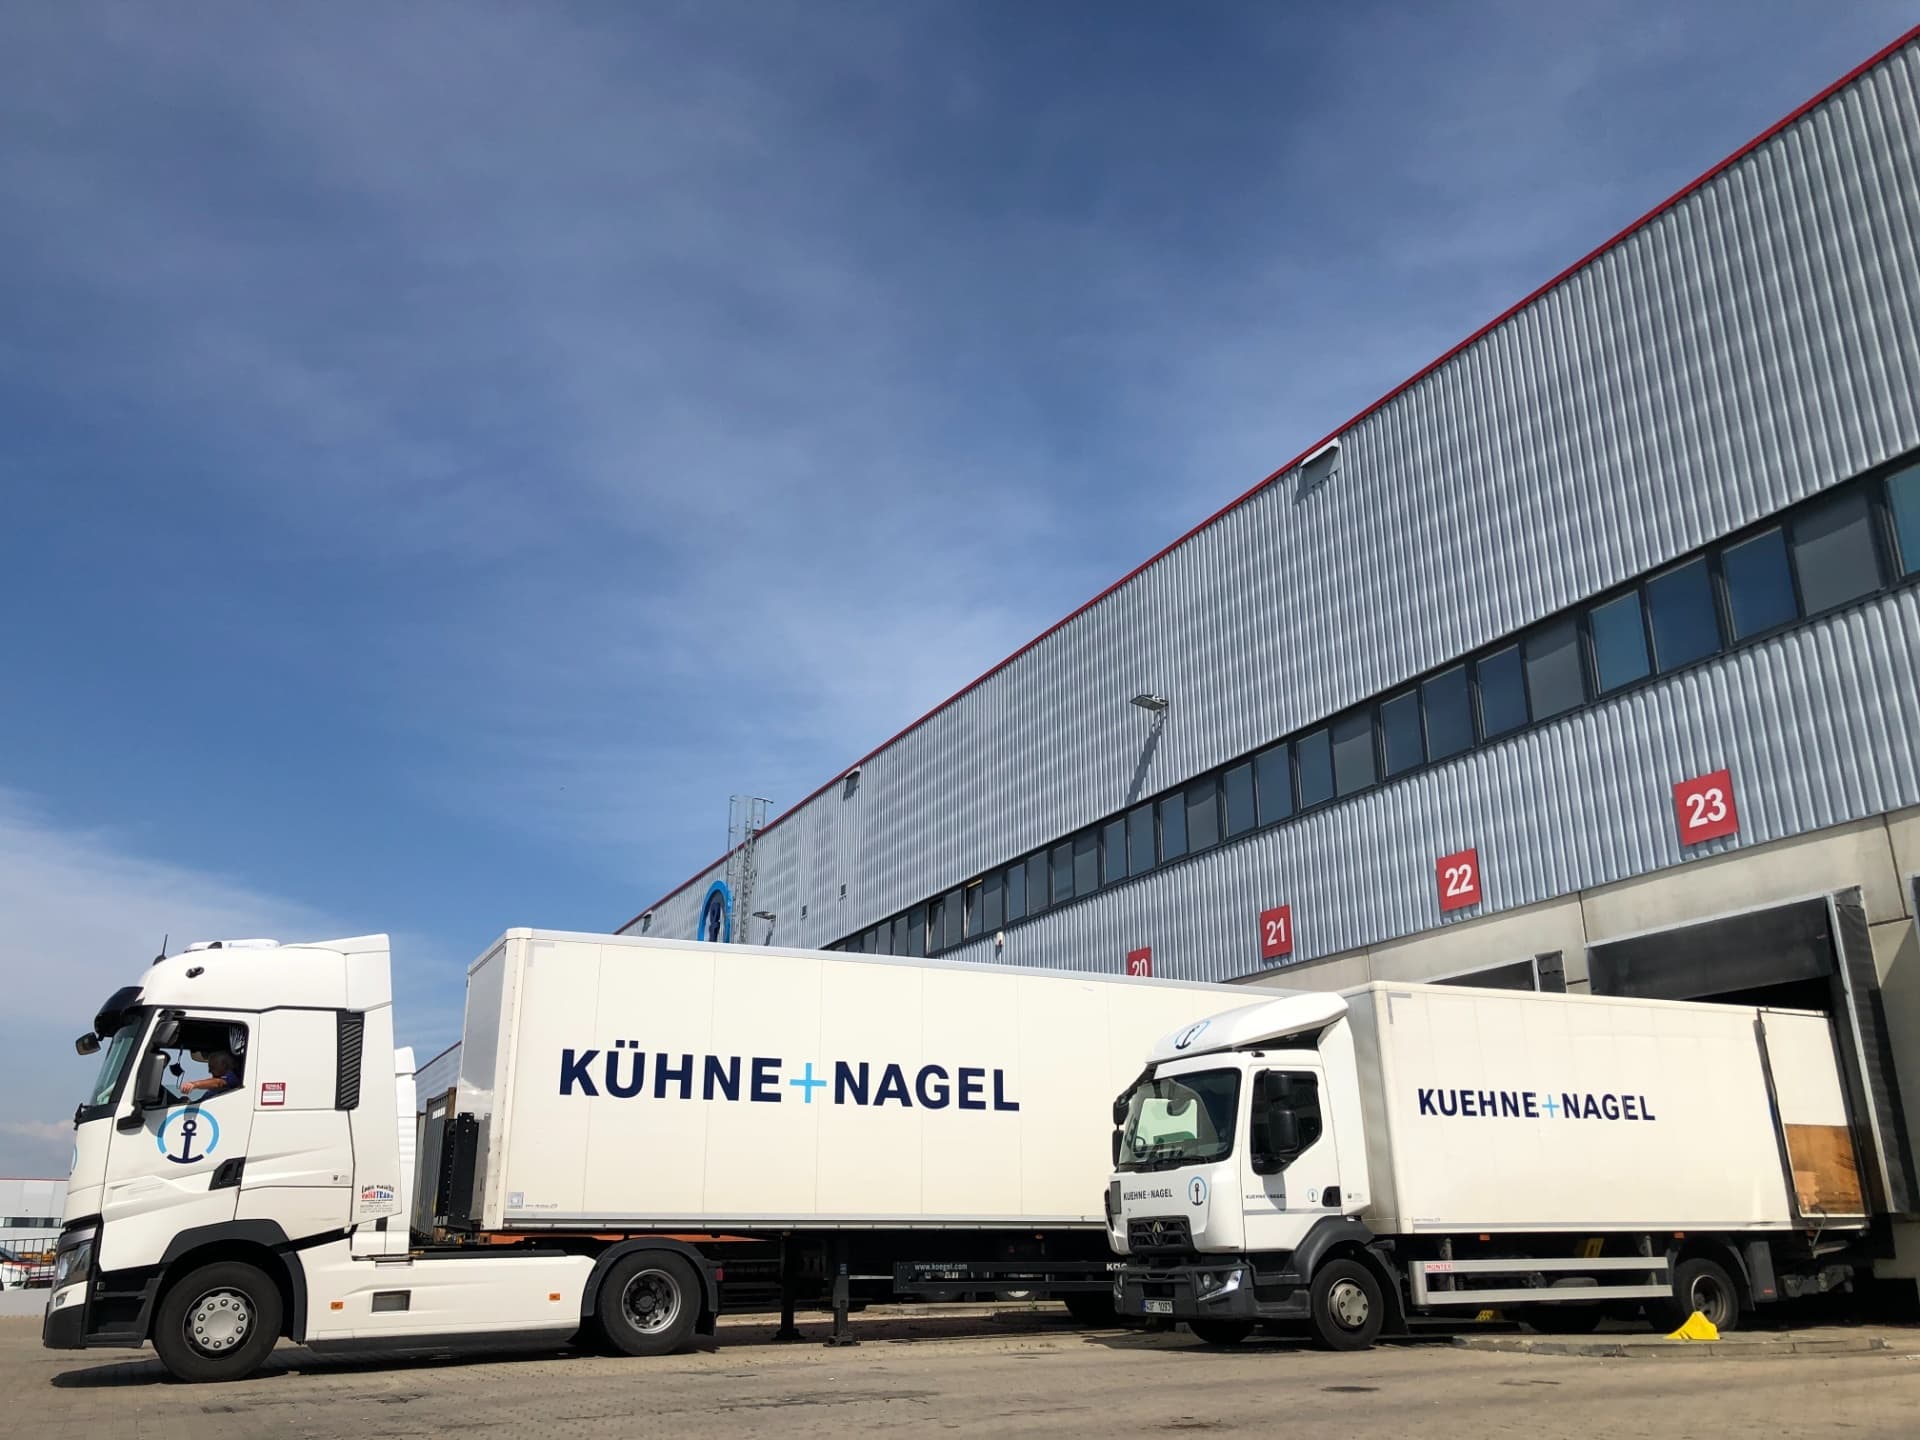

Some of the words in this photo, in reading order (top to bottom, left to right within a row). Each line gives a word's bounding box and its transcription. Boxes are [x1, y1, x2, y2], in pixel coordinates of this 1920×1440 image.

[1686, 787, 1727, 828] 23
[1444, 863, 1474, 897] 22
[1266, 917, 1285, 946] 21
[1131, 958, 1148, 976] 20
[559, 1039, 1020, 1112] KÜHNE+NAGEL
[1417, 1088, 1656, 1121] KUEHNE+NAGEL
